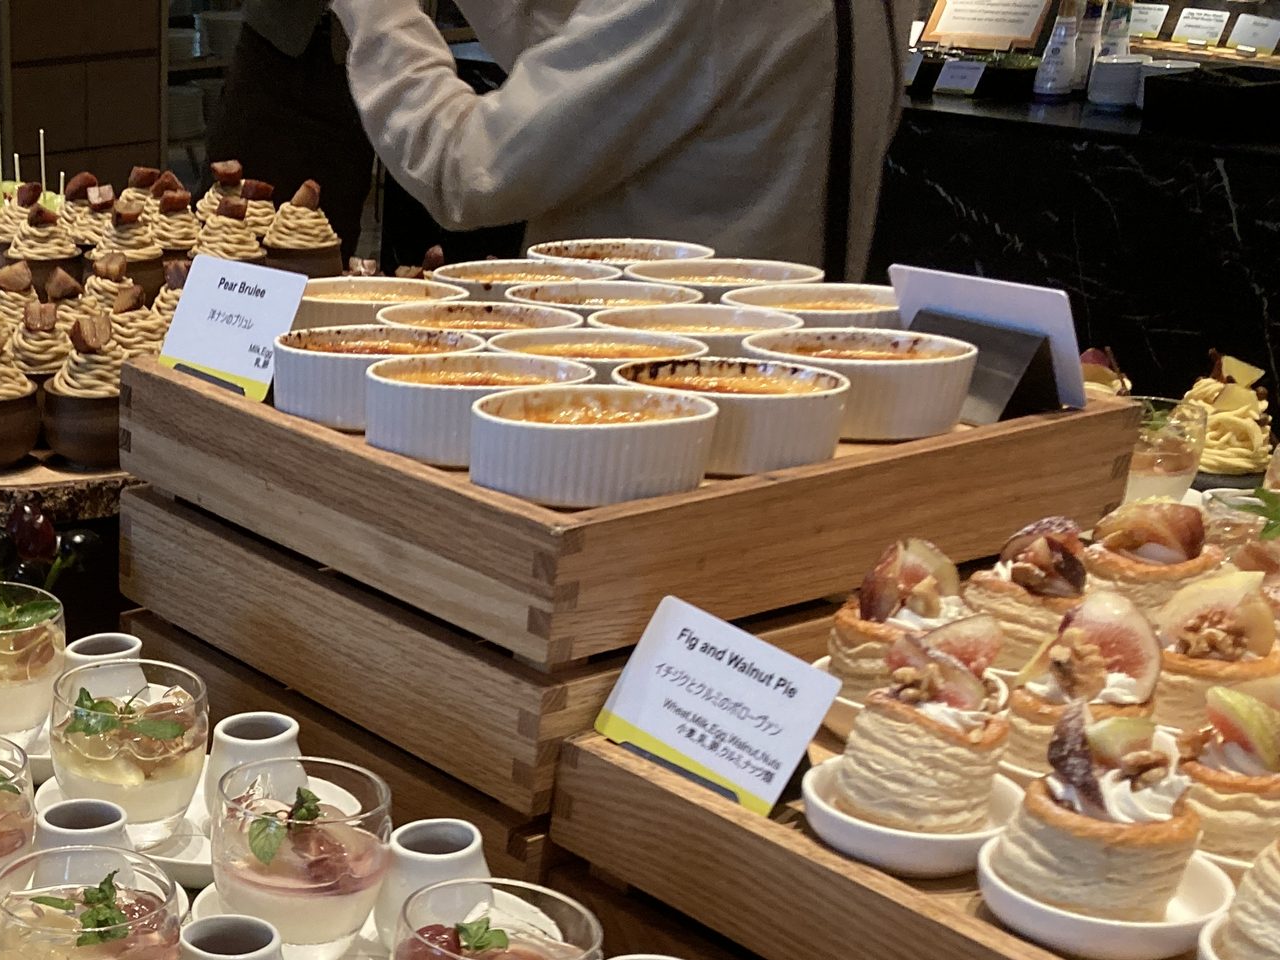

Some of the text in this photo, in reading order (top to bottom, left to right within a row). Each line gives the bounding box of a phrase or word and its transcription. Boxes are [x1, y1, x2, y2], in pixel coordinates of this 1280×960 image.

[217, 276, 266, 298] Pear Brulee
[677, 627, 798, 699] Fig and Walnut Pie
